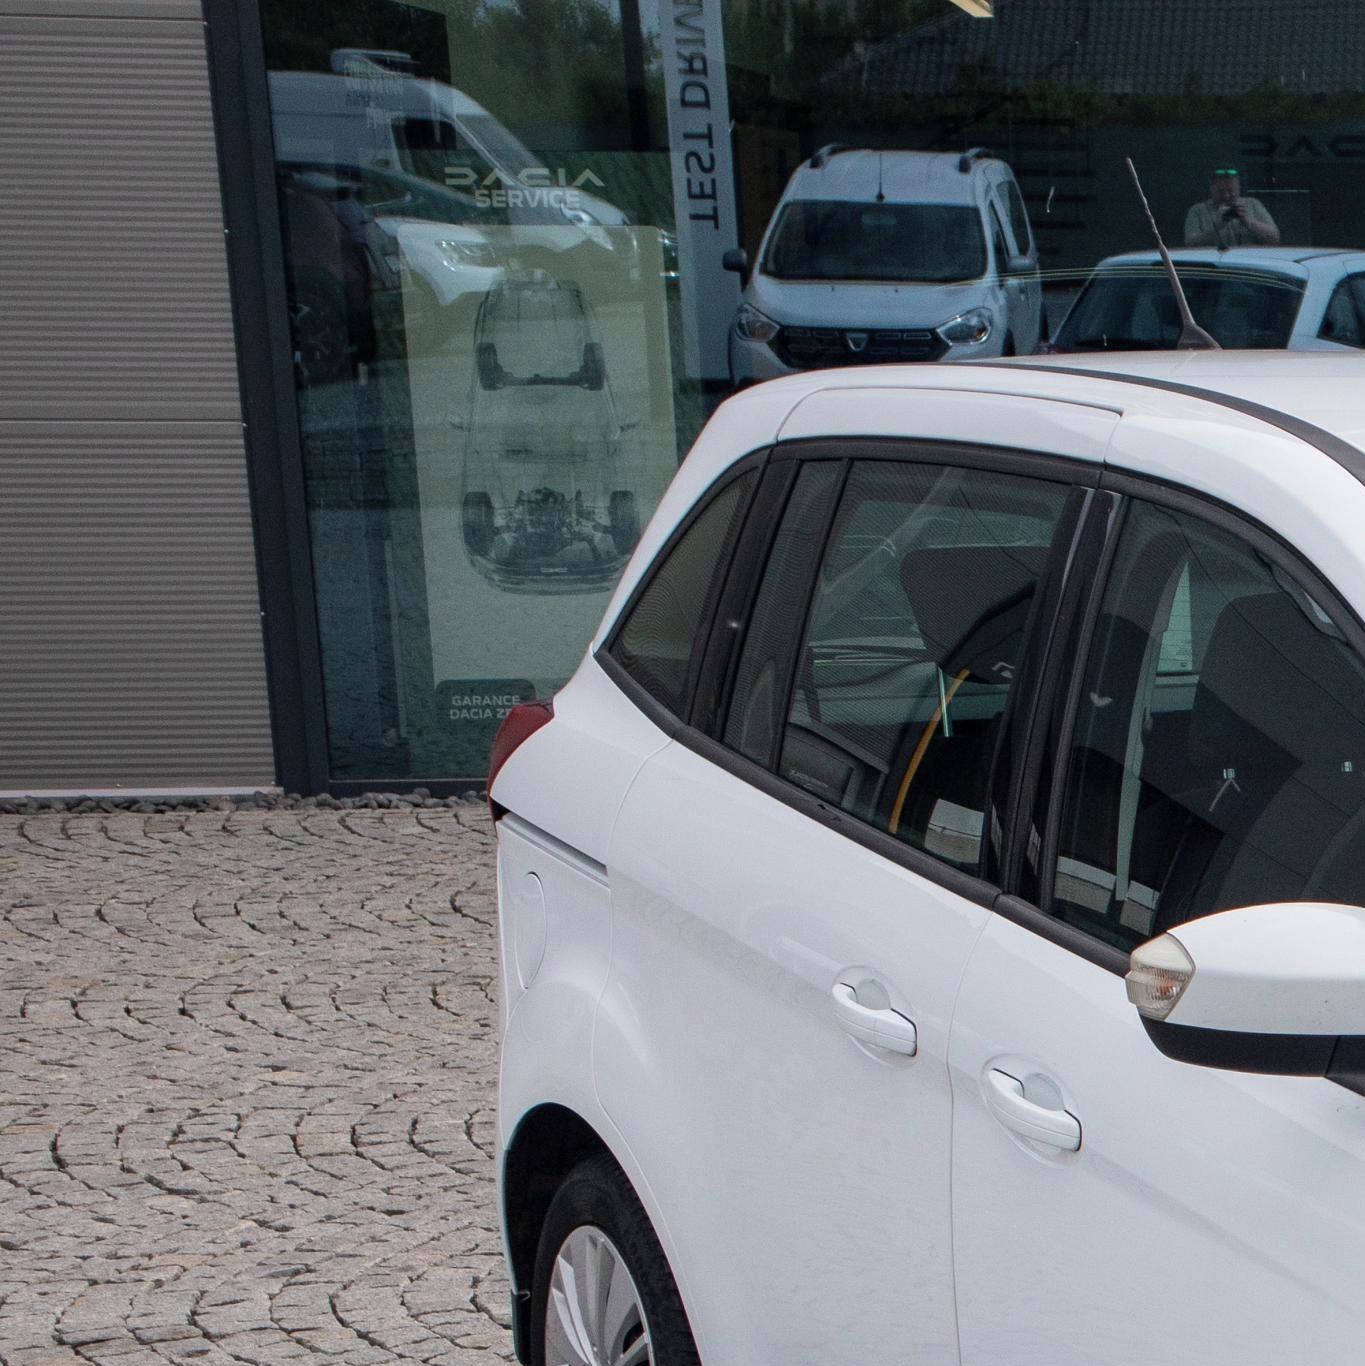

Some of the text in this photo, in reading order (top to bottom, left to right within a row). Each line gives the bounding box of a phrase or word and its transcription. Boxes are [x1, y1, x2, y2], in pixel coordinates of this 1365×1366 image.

[444, 166, 605, 187] DACIA
[474, 189, 581, 208] SERVICE
[451, 695, 521, 706] GARANCE
[449, 708, 493, 720] DACIA
